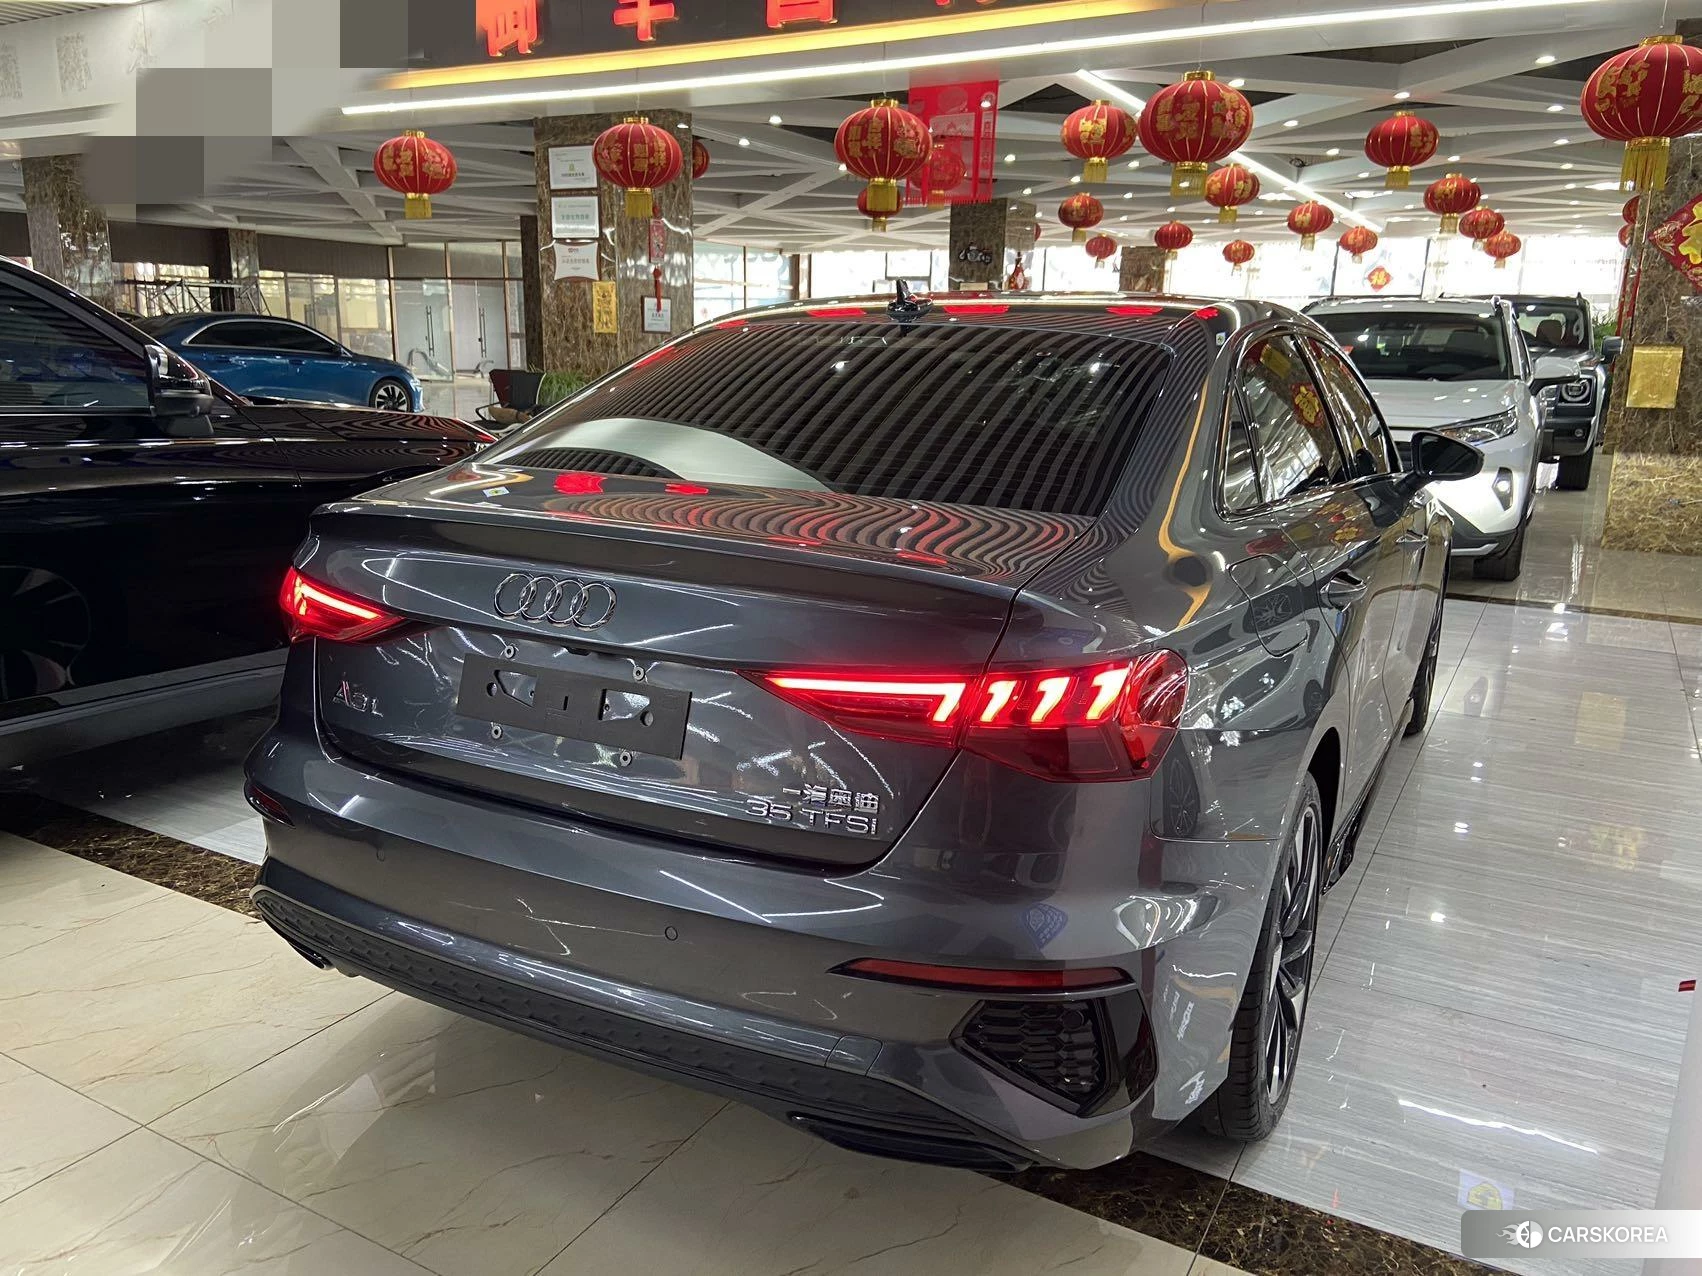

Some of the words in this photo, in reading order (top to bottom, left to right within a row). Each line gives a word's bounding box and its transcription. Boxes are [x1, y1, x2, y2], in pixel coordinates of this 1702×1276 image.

[745, 798, 793, 822] 35
[783, 783, 879, 814] 一汽奥迪
